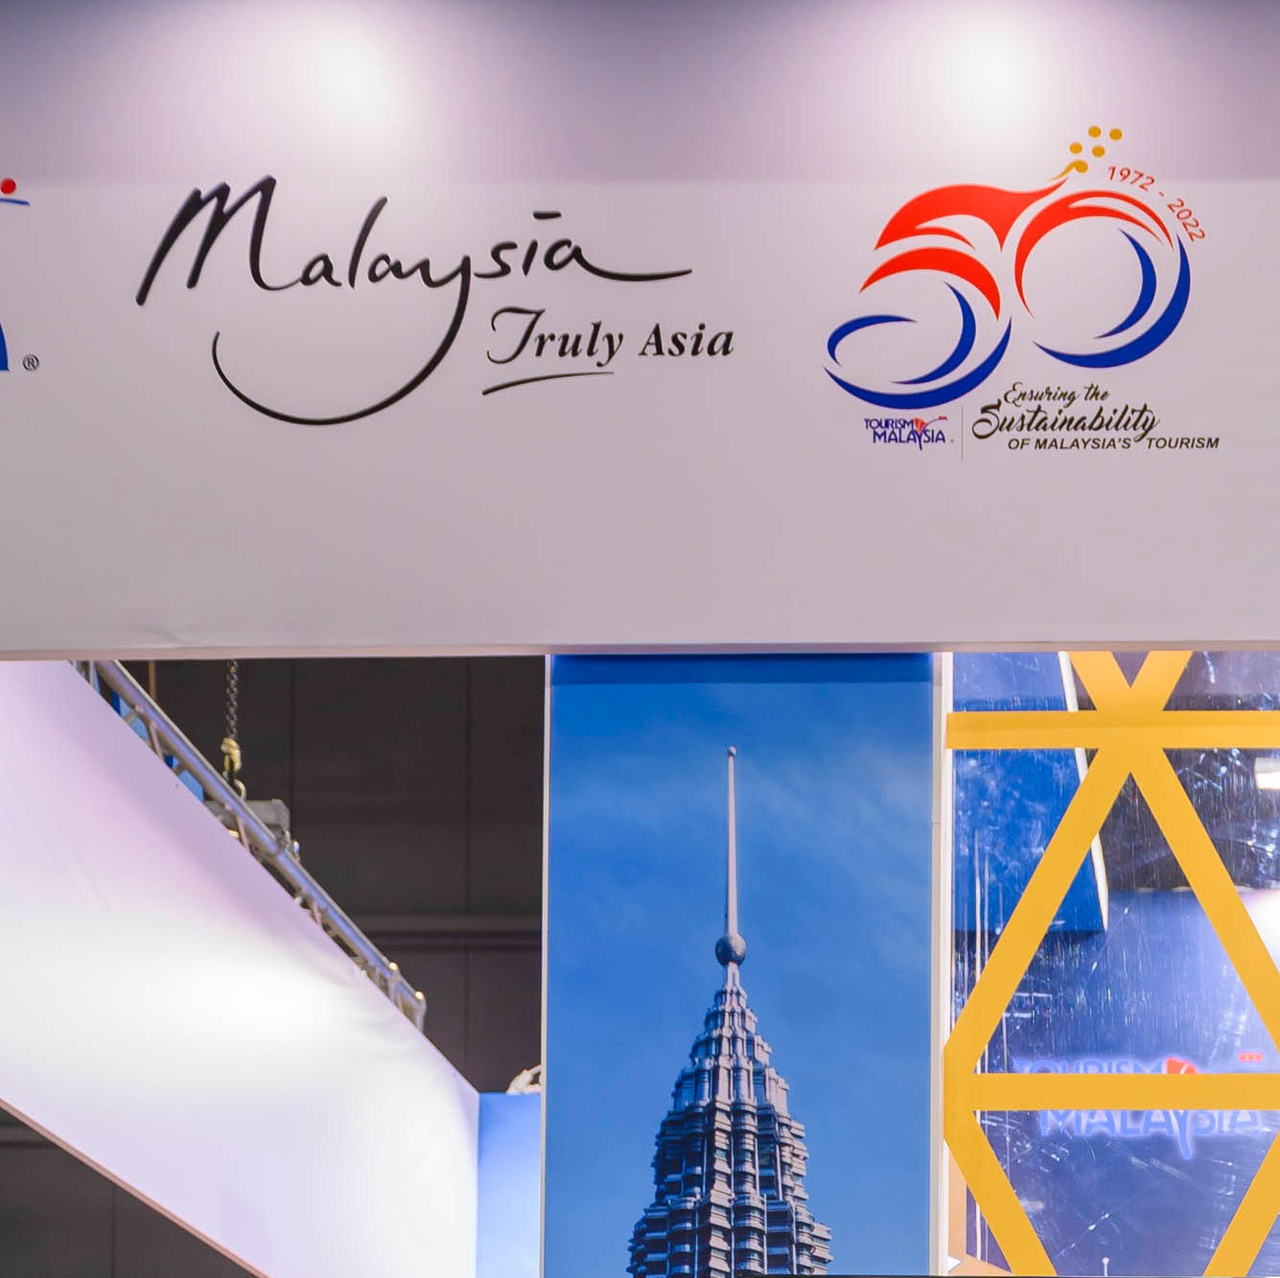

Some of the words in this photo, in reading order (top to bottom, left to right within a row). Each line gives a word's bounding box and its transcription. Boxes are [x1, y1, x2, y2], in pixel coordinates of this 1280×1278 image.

[1107, 165, 1156, 191] 1972
[1166, 197, 1207, 243] 2022
[135, 174, 693, 426] Malaysia
[486, 306, 624, 367] Truly
[638, 322, 735, 357] Asia
[1003, 381, 1082, 408] Ensuring
[1084, 382, 1111, 402] the
[864, 418, 915, 430] TOURISM
[971, 398, 1161, 443] Sustainability
[872, 429, 946, 451] MALAYSIA
[1008, 438, 1031, 450] OF
[1034, 438, 1132, 450] MALAYSIA'S
[1147, 437, 1221, 450] TOURISM
